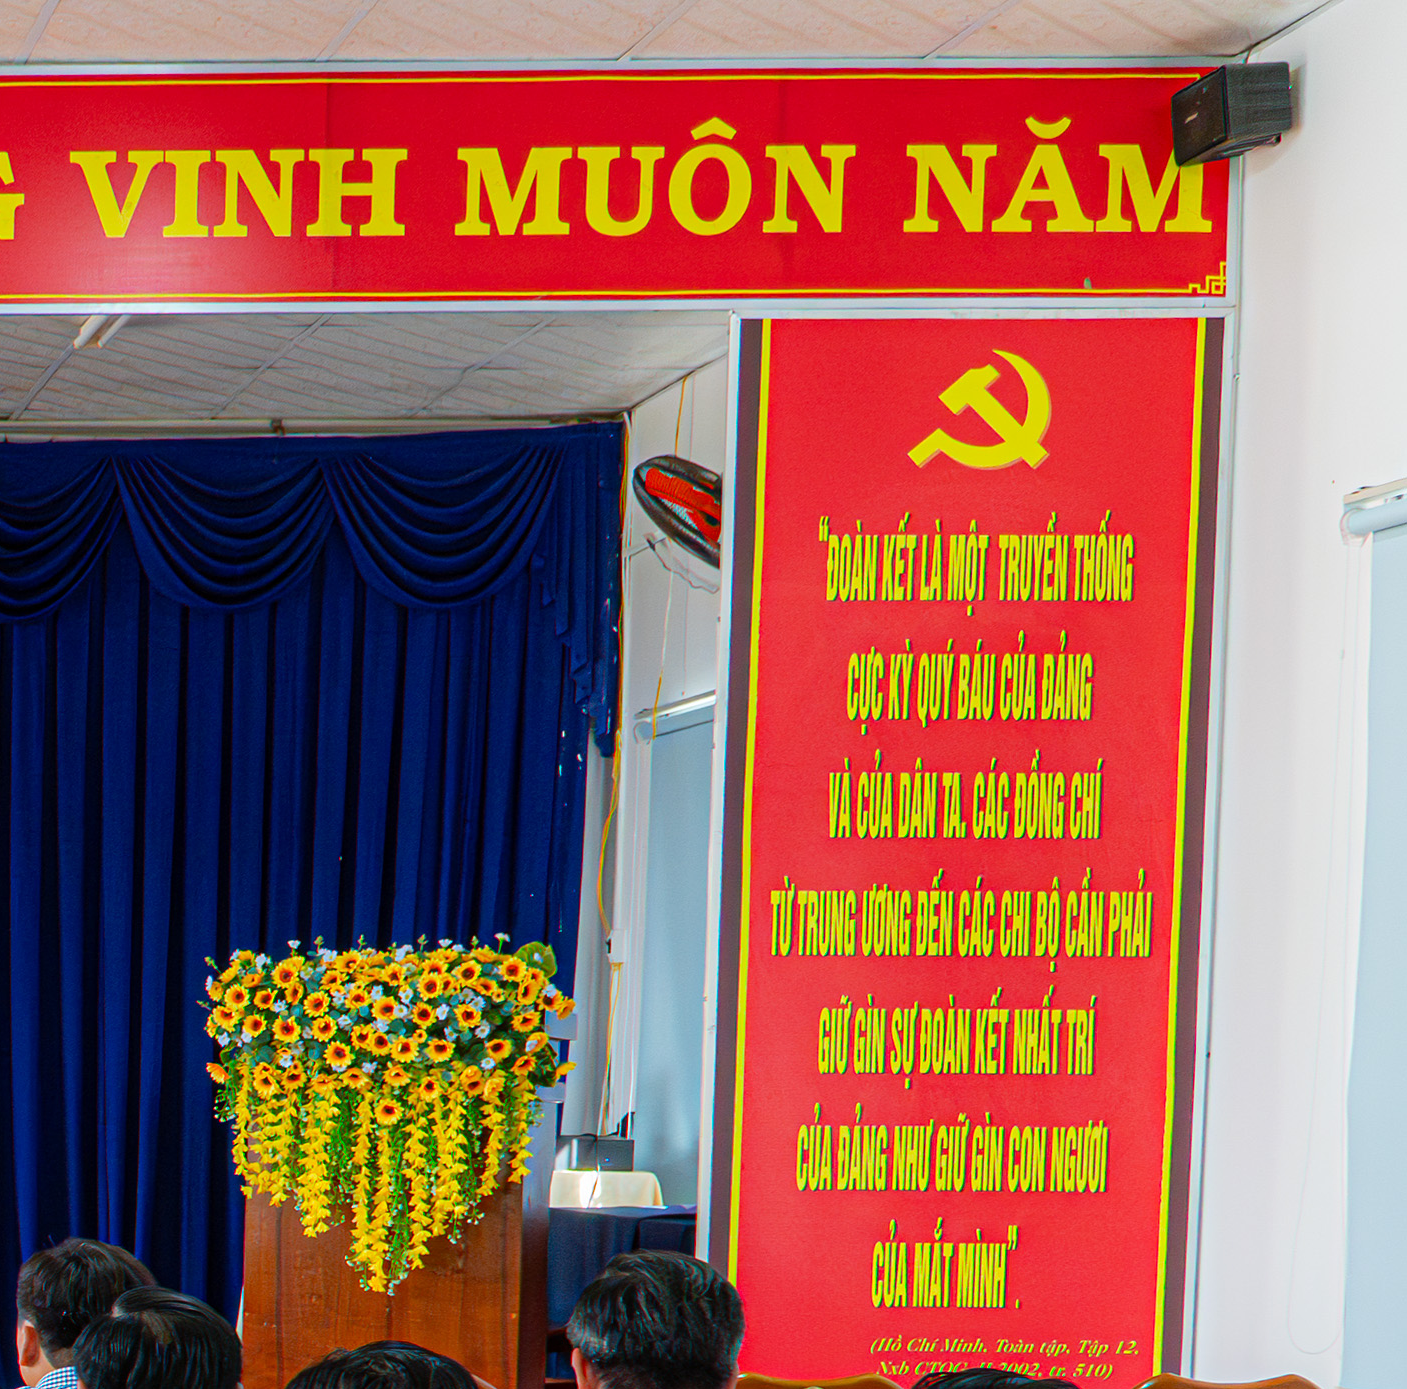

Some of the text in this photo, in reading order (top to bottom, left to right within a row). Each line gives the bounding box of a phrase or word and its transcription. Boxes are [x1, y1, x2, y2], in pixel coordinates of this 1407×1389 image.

[70, 149, 407, 238] VINH
[455, 117, 856, 236] MUÔN
[904, 114, 1213, 233] NĂM
[882, 510, 1133, 616] KẾT LÀ MỘT TRUYỀN THỐNG
[847, 630, 1093, 735] CỰC KỲ QUÝ BÁU CỦA ĐẢNG
[830, 749, 1102, 839] VÀ CỦA DÂN TA. CÁC ĐỒNG CHÍ
[771, 867, 1152, 972] TỪ TRUNG ƯƠNG ĐẾN CÁC CHI BỘ CẦN PHẢI
[818, 985, 1096, 1089] GIỮ GÌN SỰ ĐOÀN KẾT NHẤT TRÍ
[796, 1102, 1108, 1193] CỦA ĐẢNG NHƯ GIỮ GÌN CON NGƯƠI
[872, 1217, 953, 1307] CỦA MẮT
[870, 1335, 1109, 1357] (Hồ Chí Toàn Tập
[1073, 1364, 1112, 1380] 510)
